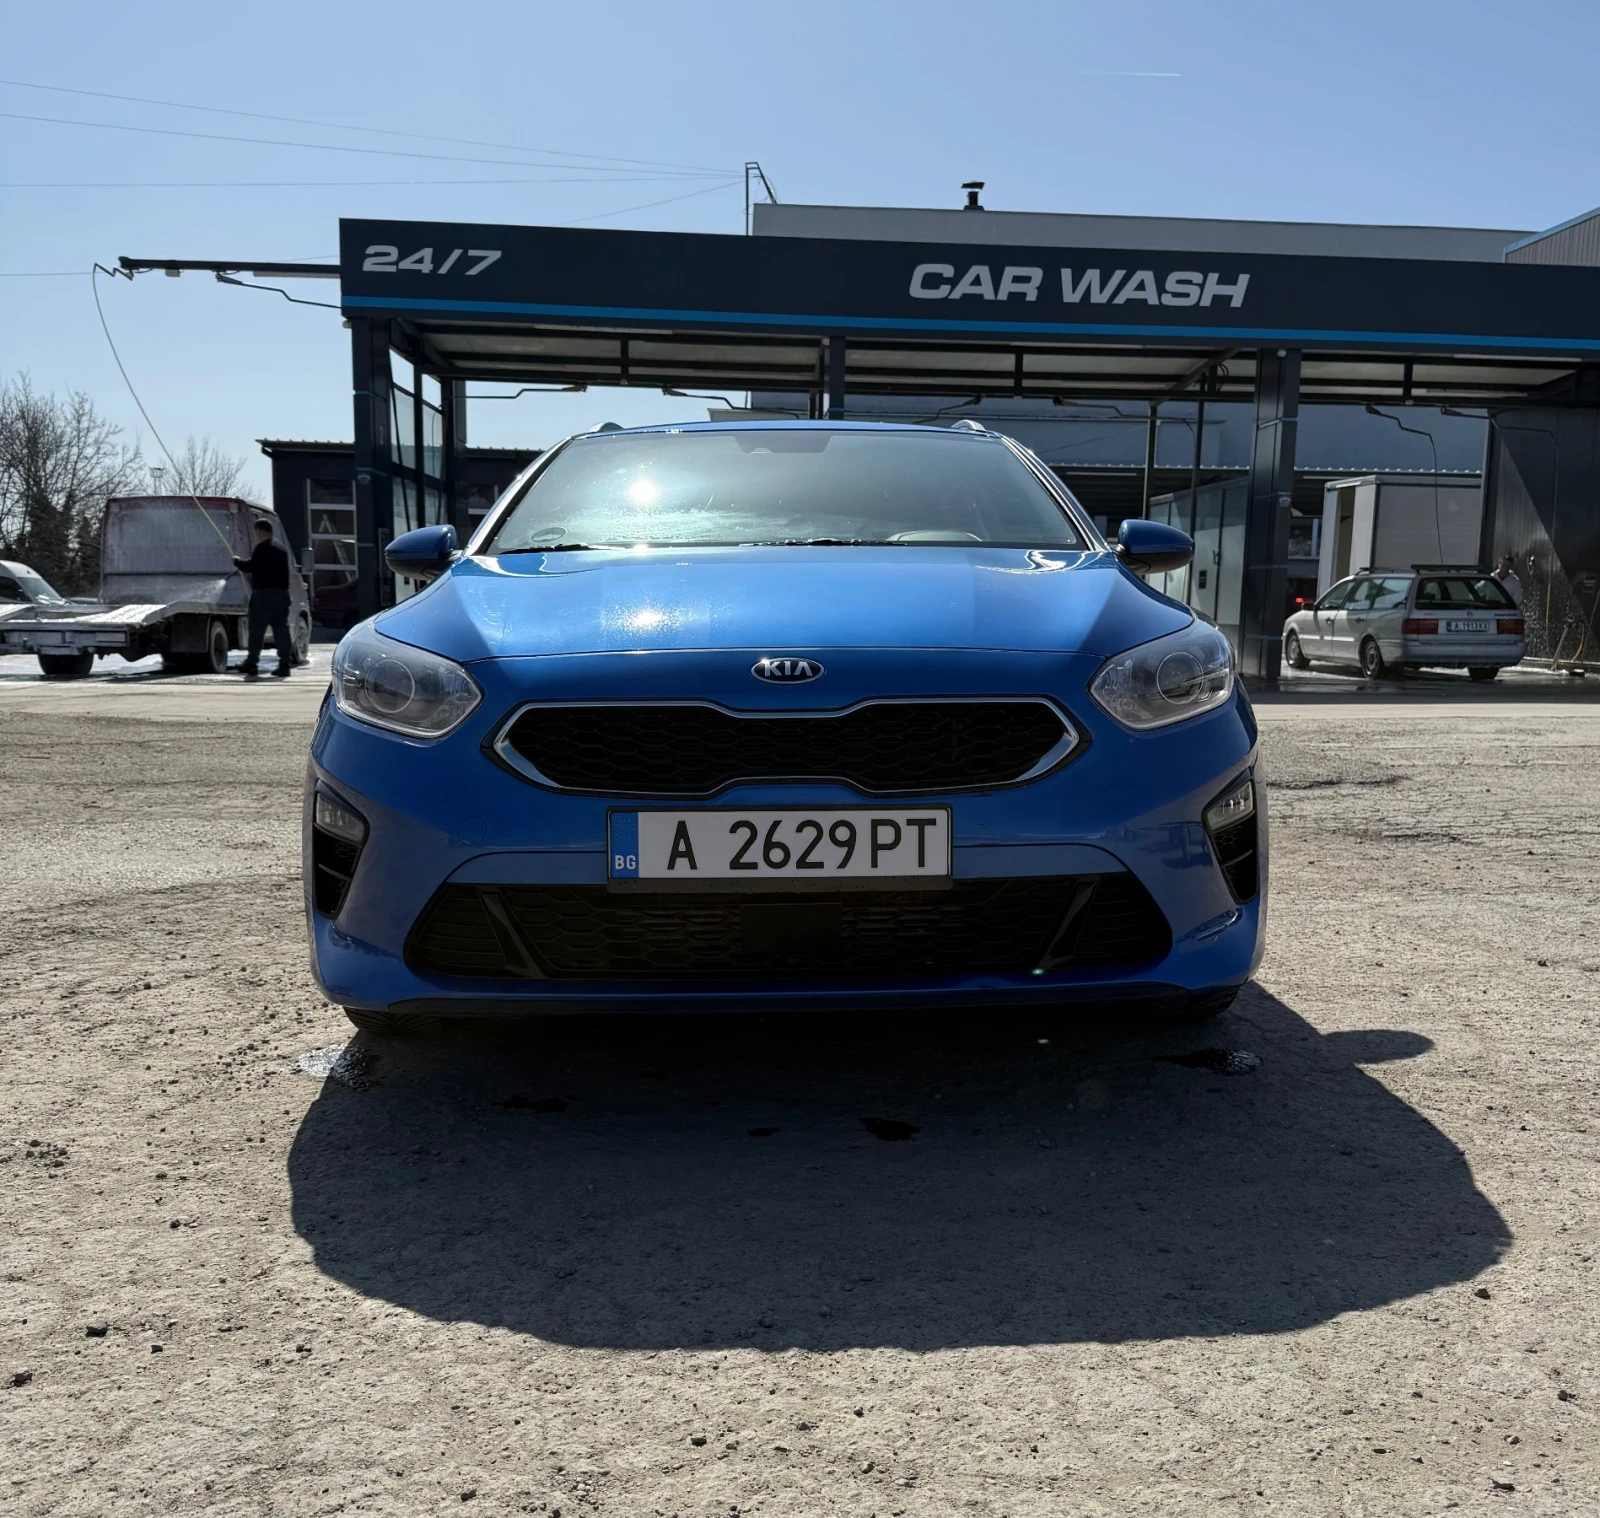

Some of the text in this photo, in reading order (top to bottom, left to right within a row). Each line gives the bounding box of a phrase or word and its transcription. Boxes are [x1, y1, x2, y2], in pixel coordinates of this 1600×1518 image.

[362, 244, 502, 275] 24/7
[909, 263, 1251, 308] CAR WASH
[764, 660, 813, 677] KIA
[667, 820, 698, 871] A
[614, 854, 636, 870] BG
